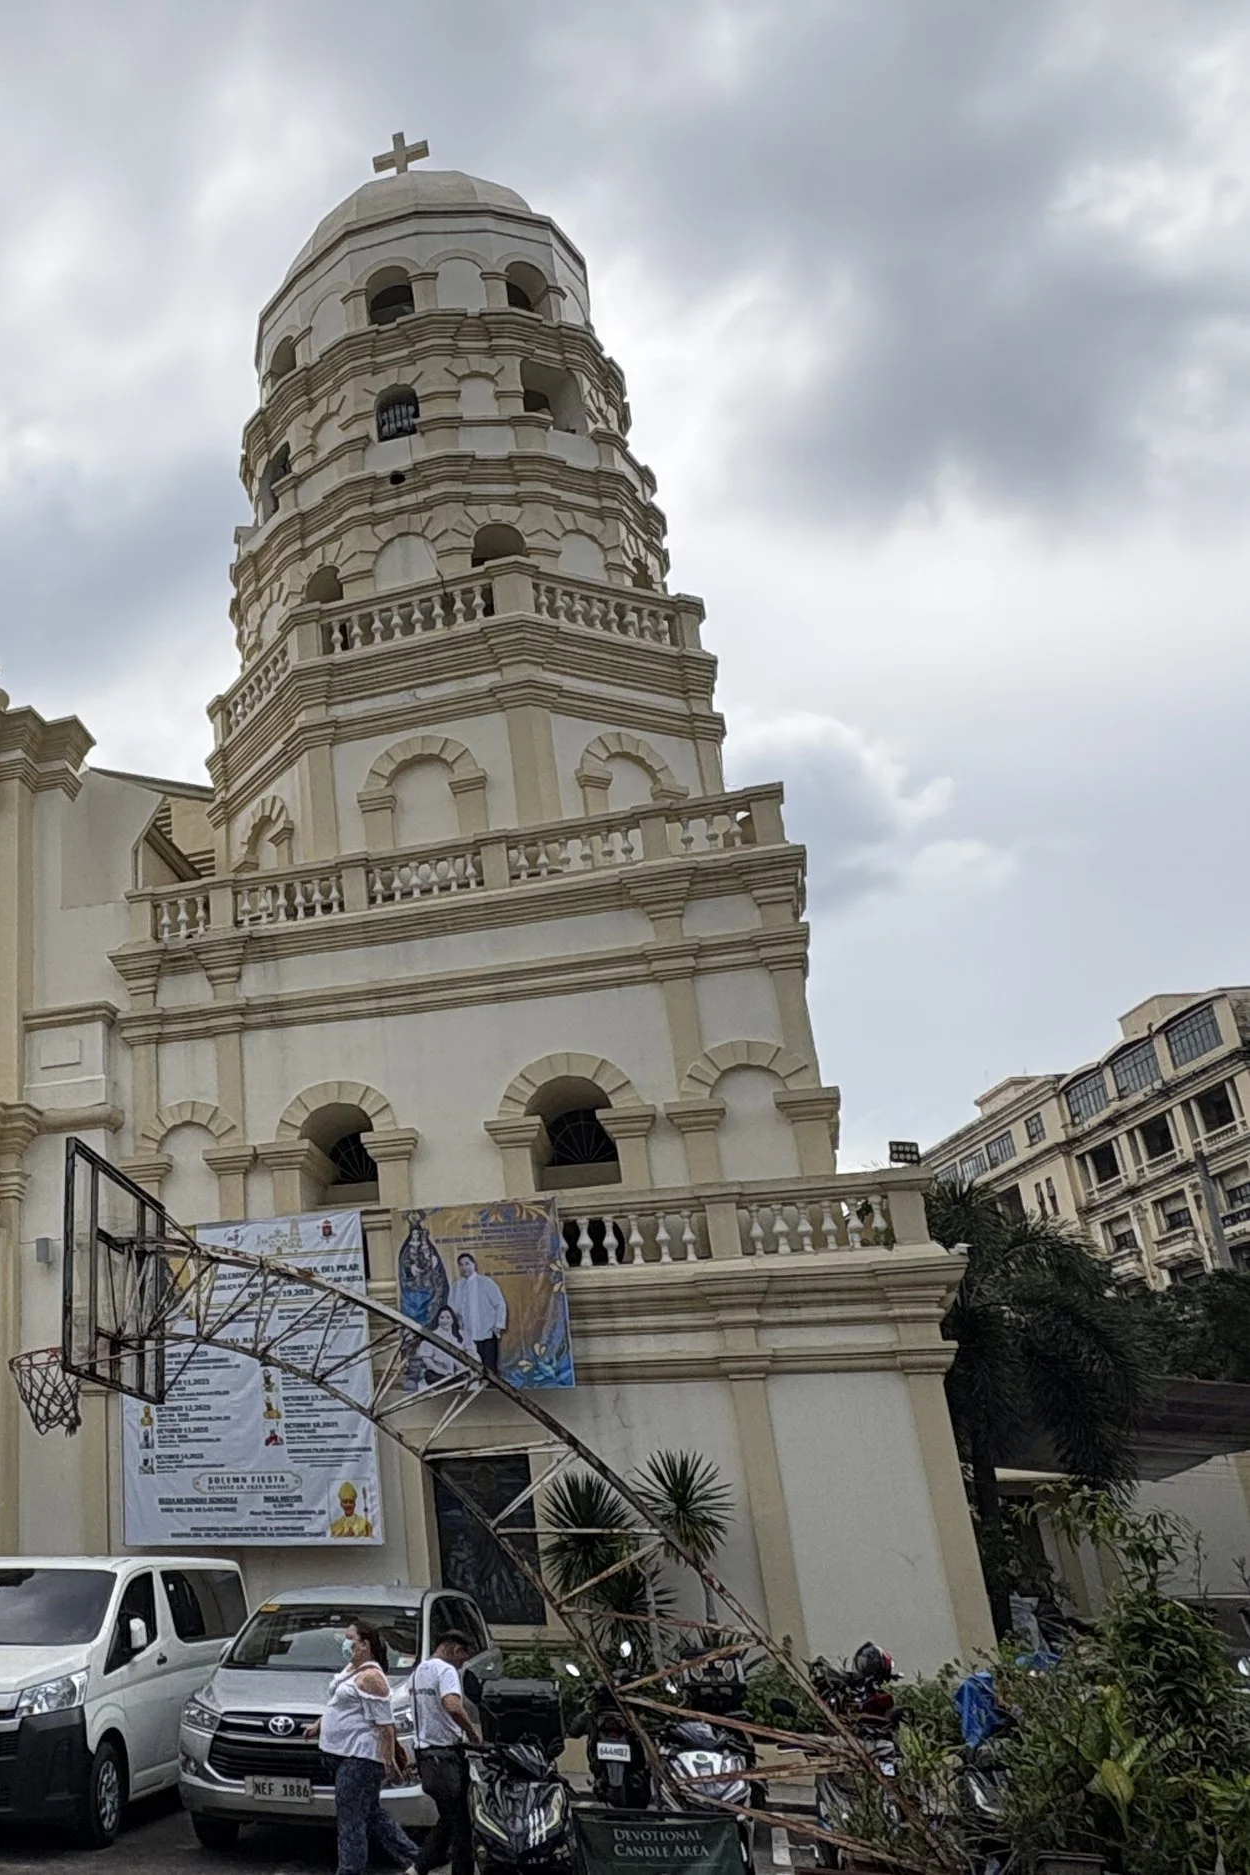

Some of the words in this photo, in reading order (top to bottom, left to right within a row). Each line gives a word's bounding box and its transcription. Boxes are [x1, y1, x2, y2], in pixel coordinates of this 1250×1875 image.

[208, 1476, 248, 1485] SOLEMN
[251, 1475, 286, 1484] FIESTA
[253, 1782, 275, 1796] NEF
[281, 1783, 310, 1798] 1886
[613, 1828, 703, 1842] DEVOTIONAL
[613, 1843, 668, 1858] CANDLE
[673, 1844, 711, 1858] AREA
